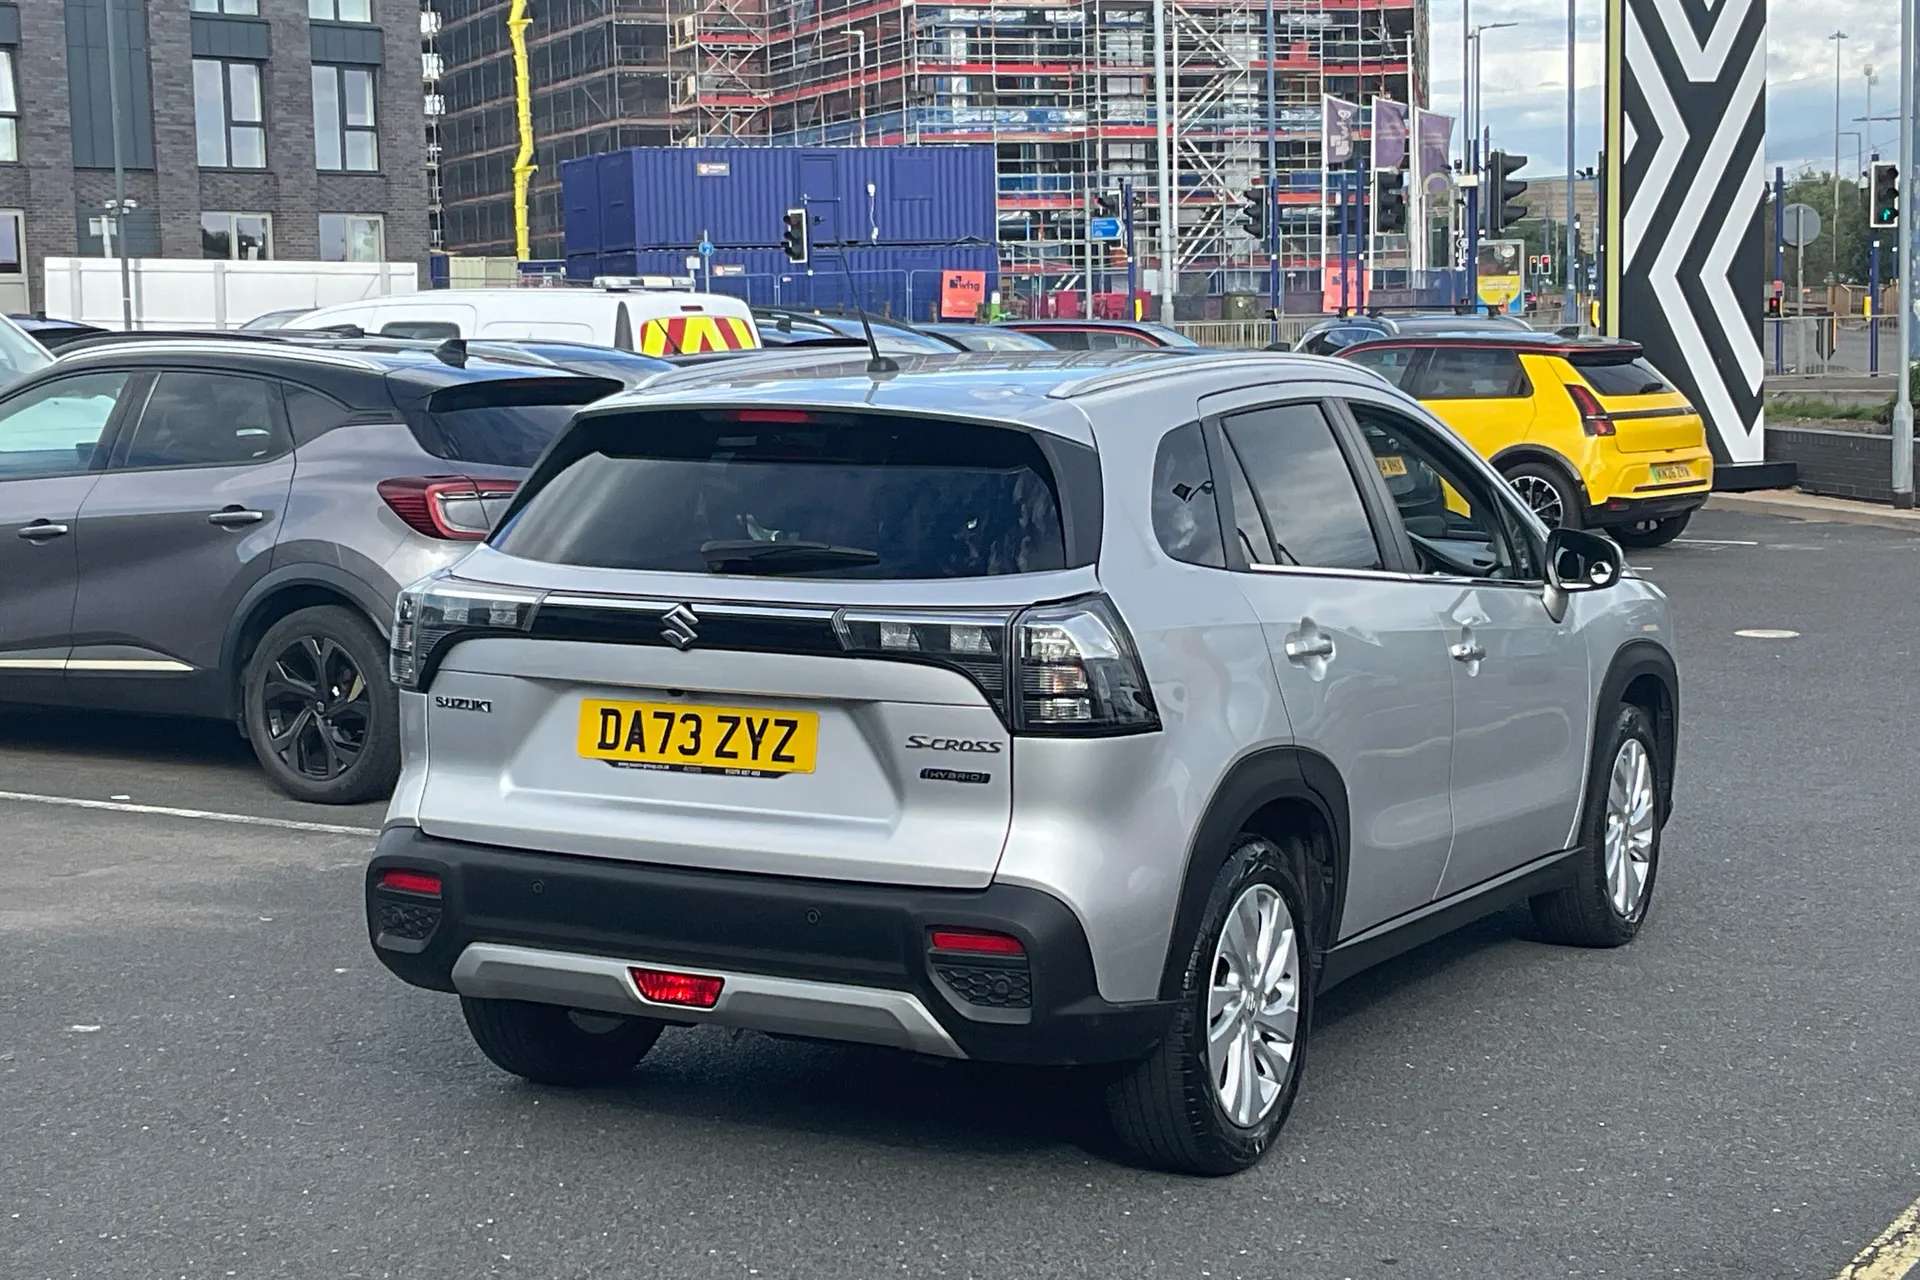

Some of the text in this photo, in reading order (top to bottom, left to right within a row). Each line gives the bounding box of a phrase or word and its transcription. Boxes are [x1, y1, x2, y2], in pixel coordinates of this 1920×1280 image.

[436, 696, 491, 712] SUZUKI
[597, 707, 798, 763] DA73 ZYZ
[927, 769, 983, 782] HYBRID
